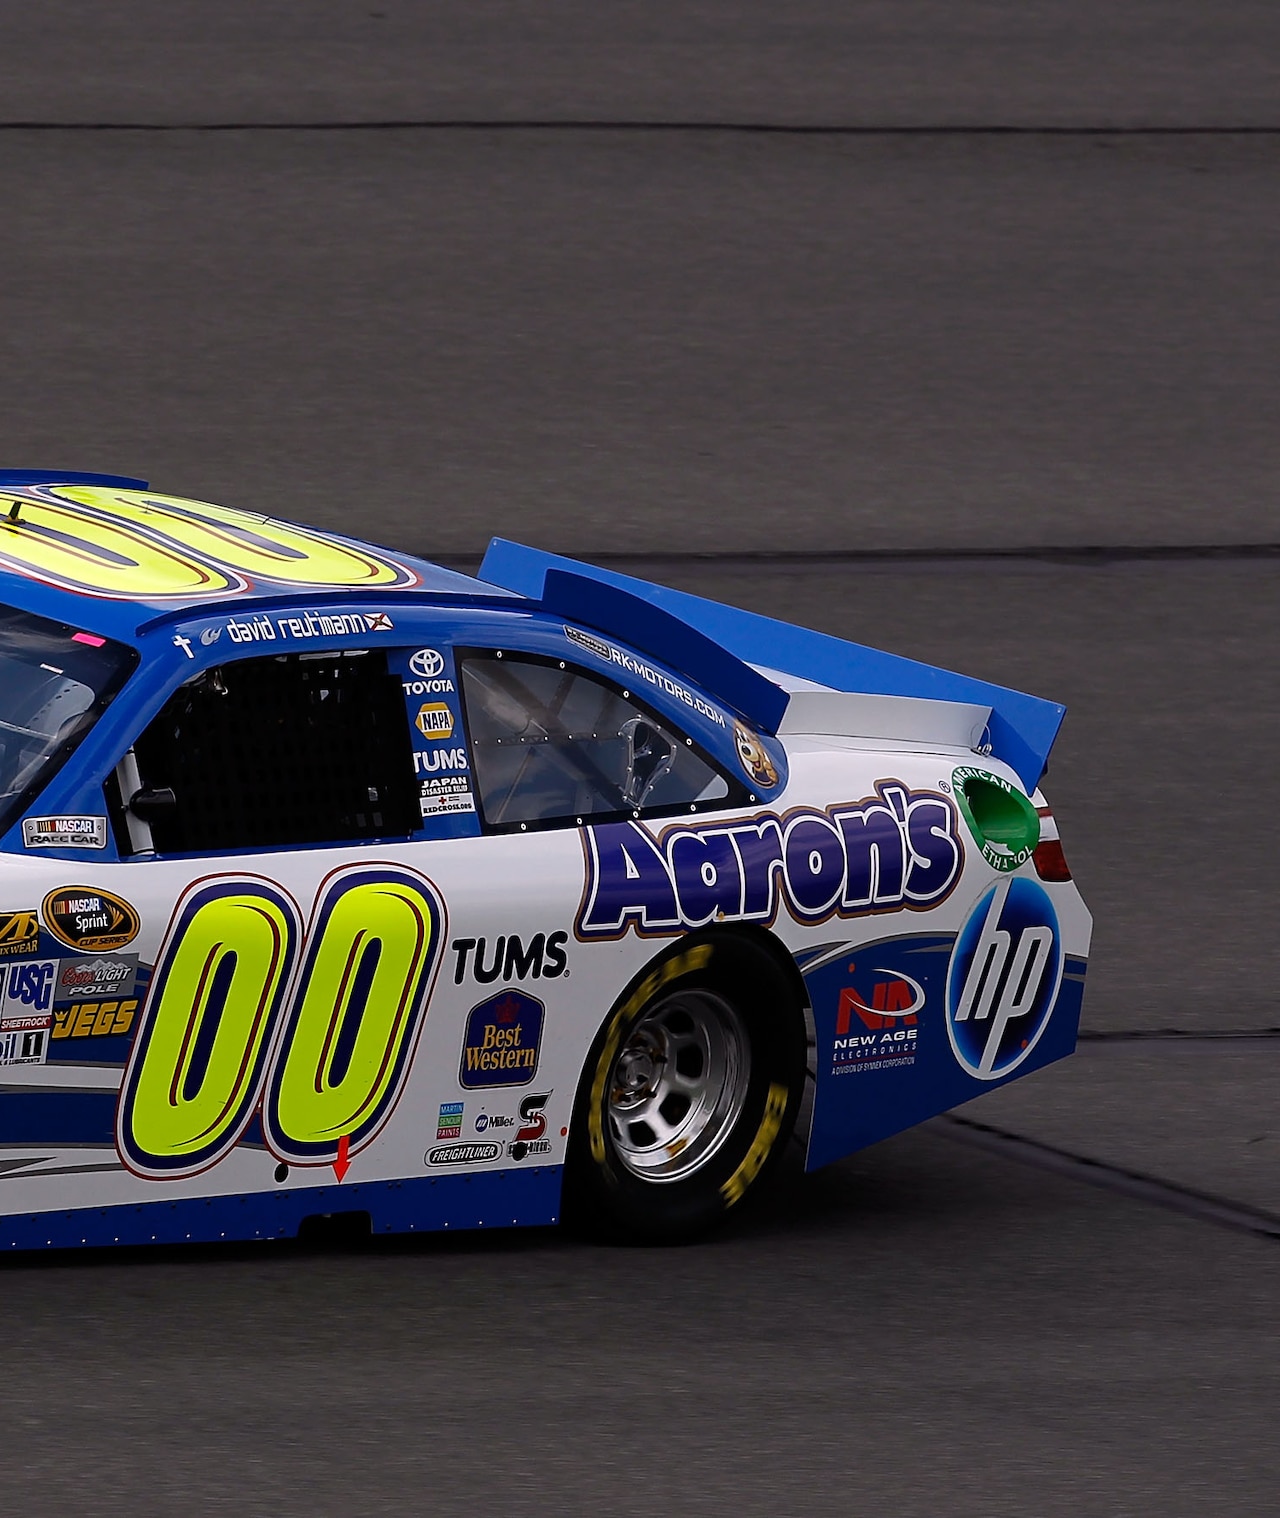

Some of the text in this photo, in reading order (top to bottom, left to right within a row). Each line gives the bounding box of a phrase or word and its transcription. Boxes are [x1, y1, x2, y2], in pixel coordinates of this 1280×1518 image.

[227, 611, 367, 643] david reutimann
[402, 680, 455, 696] TOYOTA
[611, 648, 726, 729] RK-MOTORS.COM
[421, 711, 450, 731] NAPA
[421, 776, 467, 789] JAPAN
[953, 767, 1012, 795] AMERICAN
[421, 785, 453, 796] DISASTER
[55, 820, 93, 833] NASCAR
[71, 835, 99, 845] CAR
[580, 787, 960, 933] Aaron's
[69, 898, 100, 913] NASCAR
[75, 912, 108, 932] Sprint
[10, 940, 38, 955] WEAR
[79, 935, 128, 946] CUP SERIES
[452, 930, 569, 985] TUMS
[95, 966, 132, 982] LIGHT
[954, 877, 1054, 1072] hp
[7, 962, 54, 1011] USG
[69, 983, 120, 995] POLE
[0, 1017, 49, 1029] SHEETROCK
[51, 1000, 139, 1039] JEGS
[119, 865, 445, 1176] 00
[28, 1033, 37, 1056] 1
[482, 1022, 523, 1049] Best
[834, 1029, 918, 1049] NEW AGE
[466, 1046, 536, 1072] Western
[833, 1041, 917, 1061] ELECTRONICS
[439, 1104, 464, 1114] MARTIN
[438, 1116, 462, 1126] SENOUR
[488, 1115, 515, 1129] Miller
[437, 1127, 461, 1137] PAINTS
[431, 1145, 496, 1162] FREIGHTLINER
